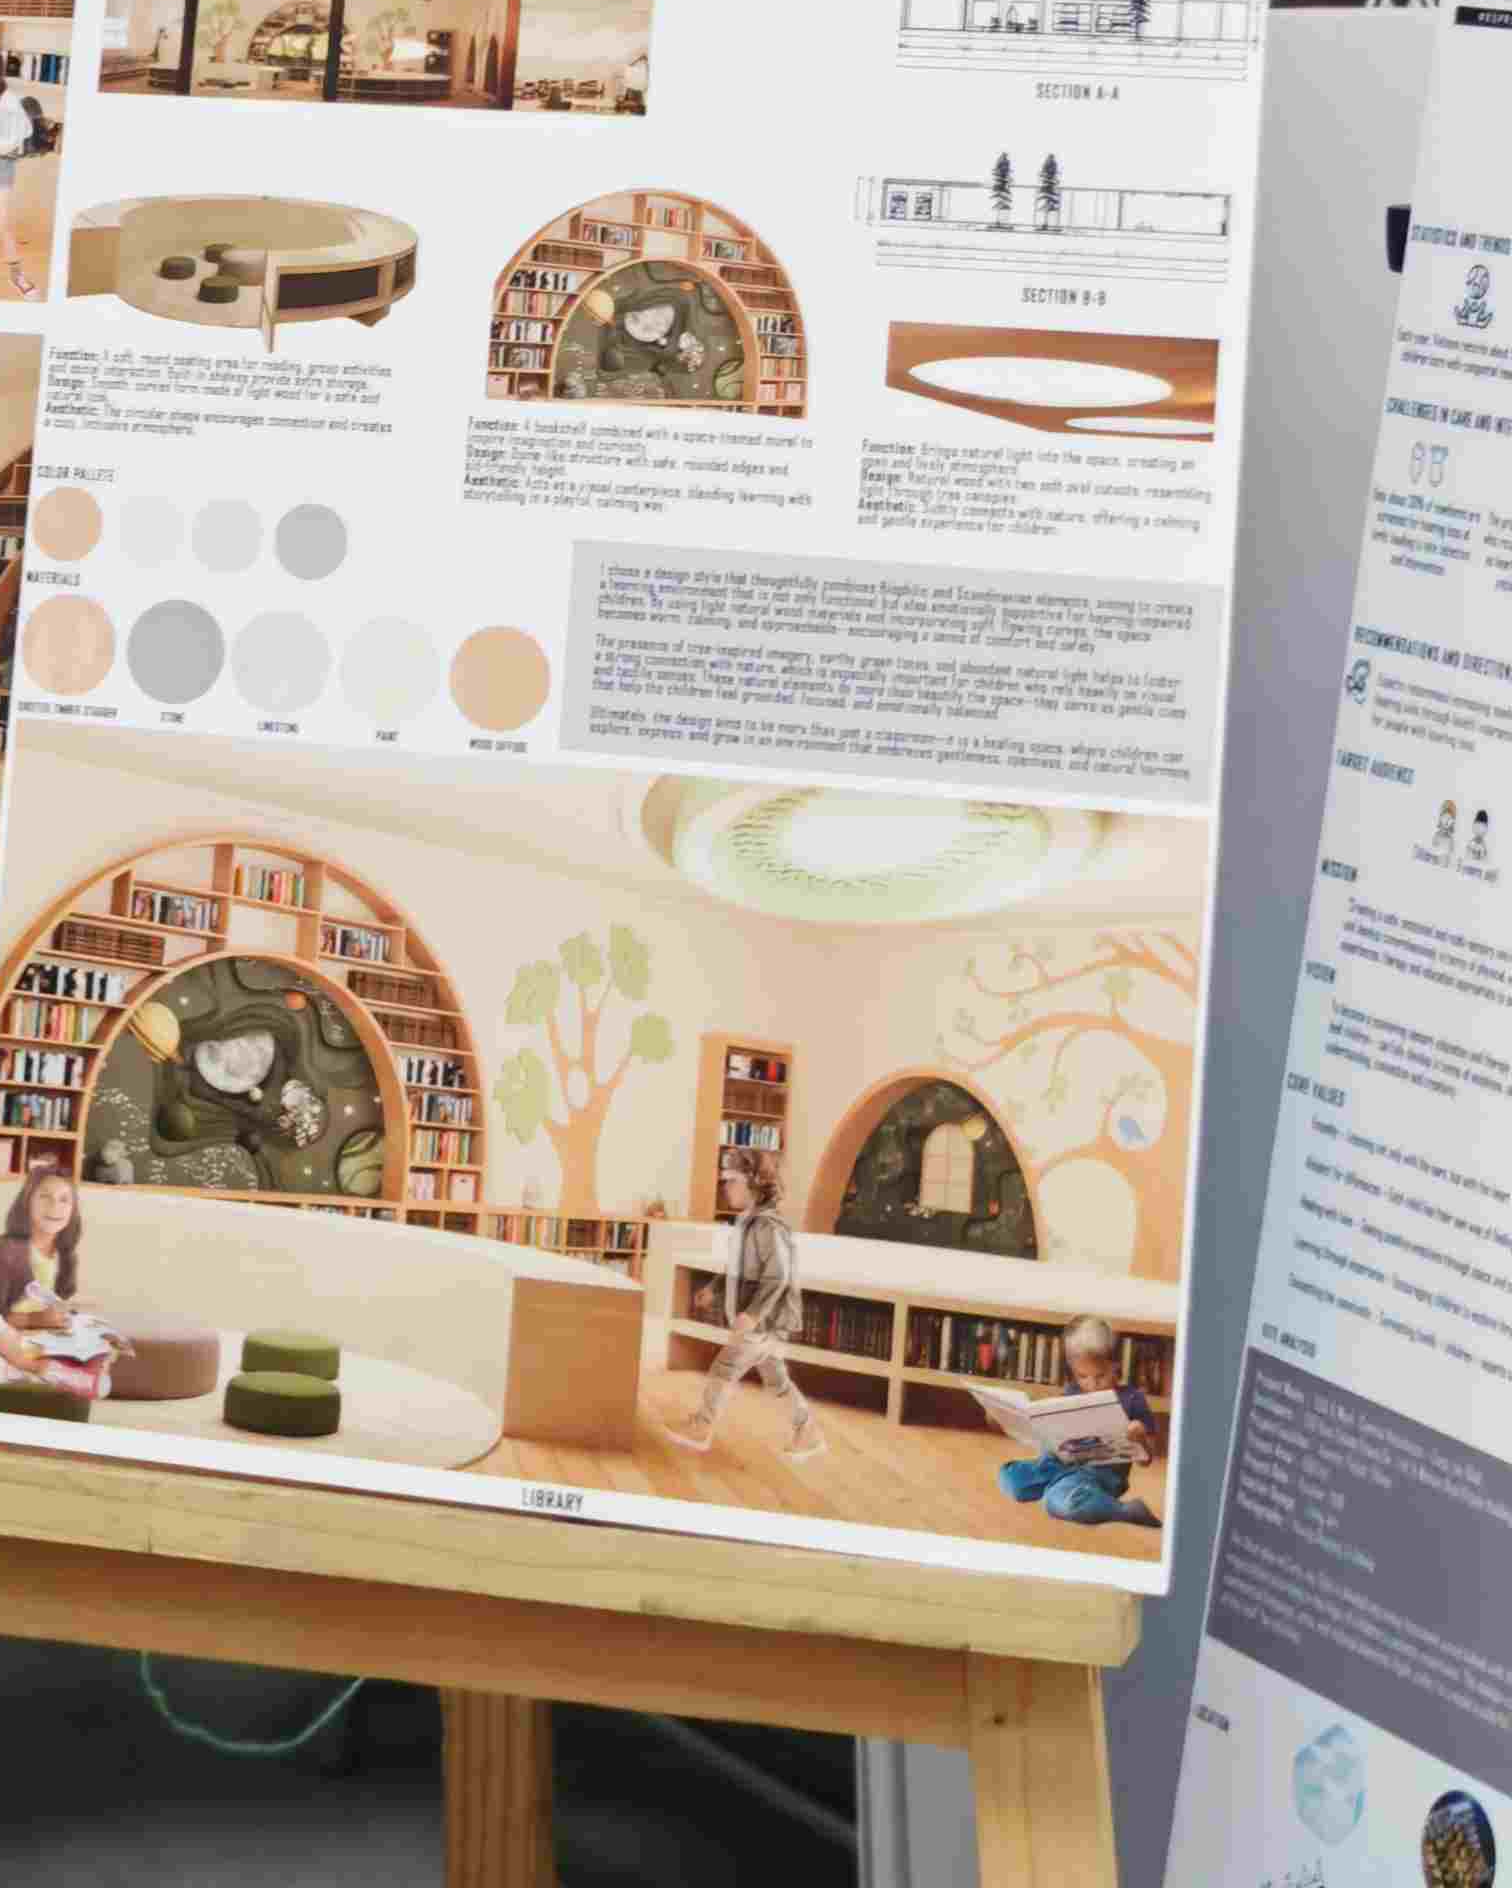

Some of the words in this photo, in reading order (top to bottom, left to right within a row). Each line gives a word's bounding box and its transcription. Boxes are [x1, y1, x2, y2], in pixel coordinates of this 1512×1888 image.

[1036, 83, 1091, 100] SECTION
[1096, 85, 1120, 101] A-A
[1021, 287, 1078, 305] SECTION
[466, 418, 520, 434] Function:
[37, 465, 69, 478] COLOR
[520, 1487, 584, 1513] LIBRARY
